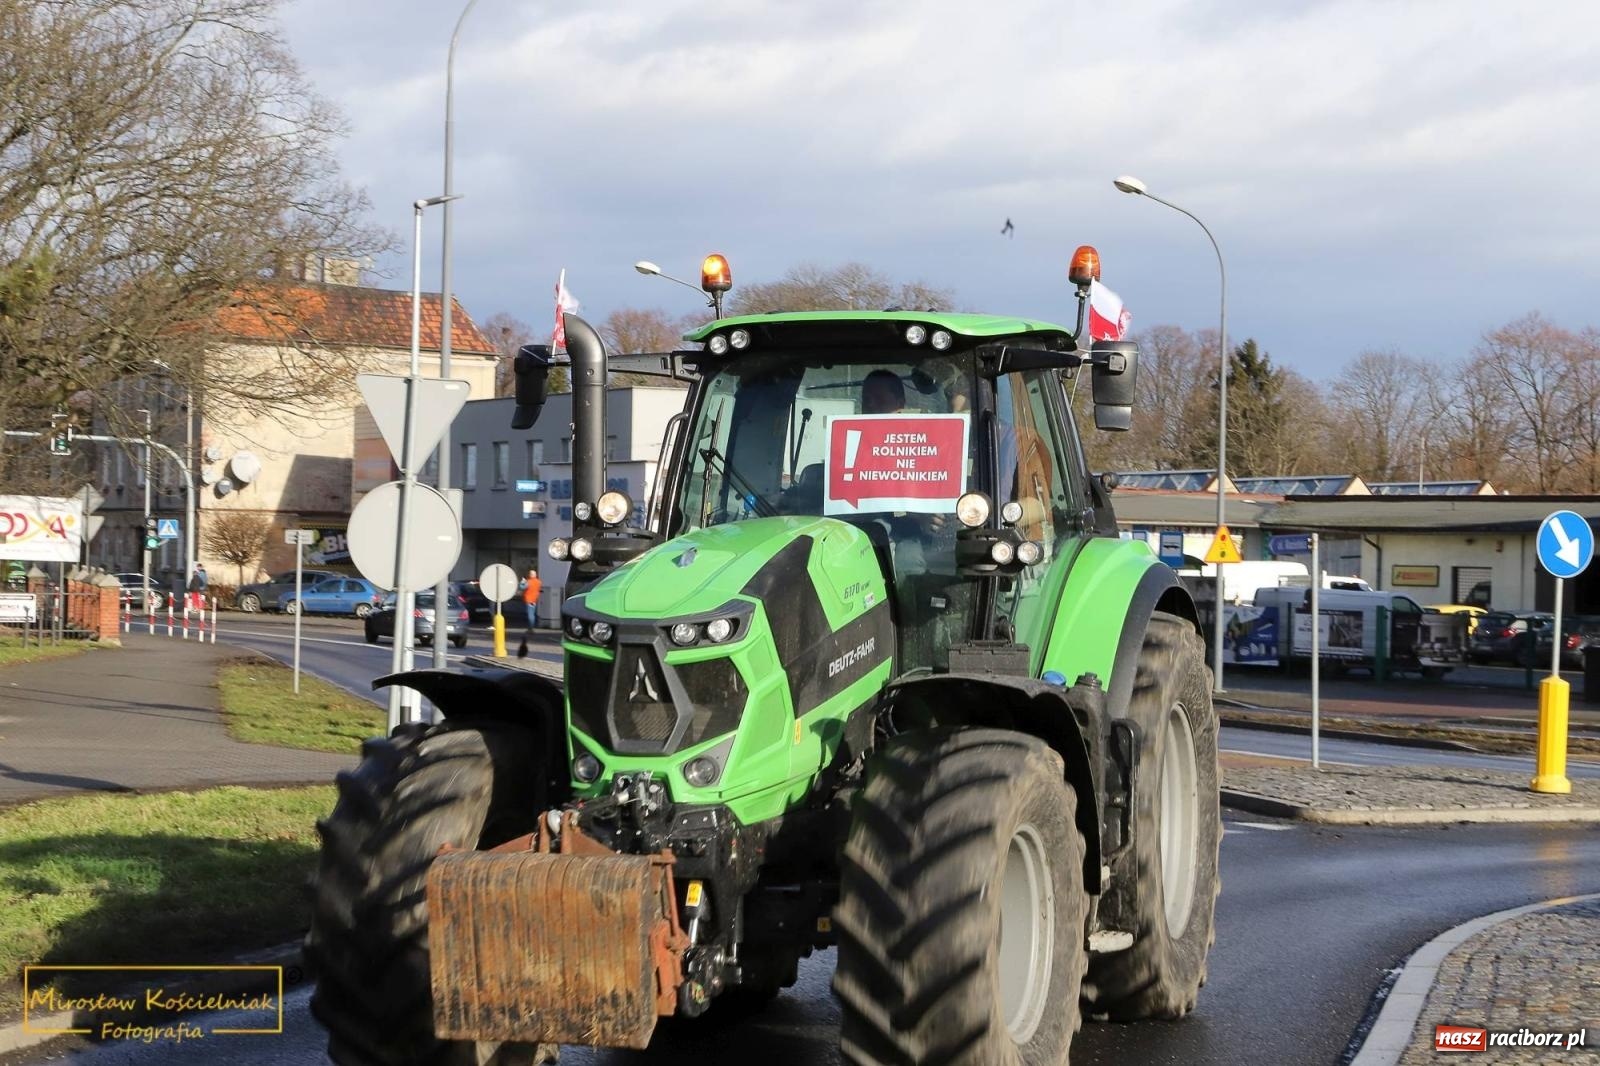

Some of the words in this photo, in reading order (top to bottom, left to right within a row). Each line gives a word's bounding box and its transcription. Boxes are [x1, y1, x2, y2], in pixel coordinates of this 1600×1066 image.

[883, 433, 927, 444] JESTEM
[872, 446, 938, 456] ROLNIKIEM
[896, 459, 916, 469] NIE
[859, 471, 948, 481] NIEWOLNIKIEM
[828, 637, 875, 678] DEUTZ-FAHR
